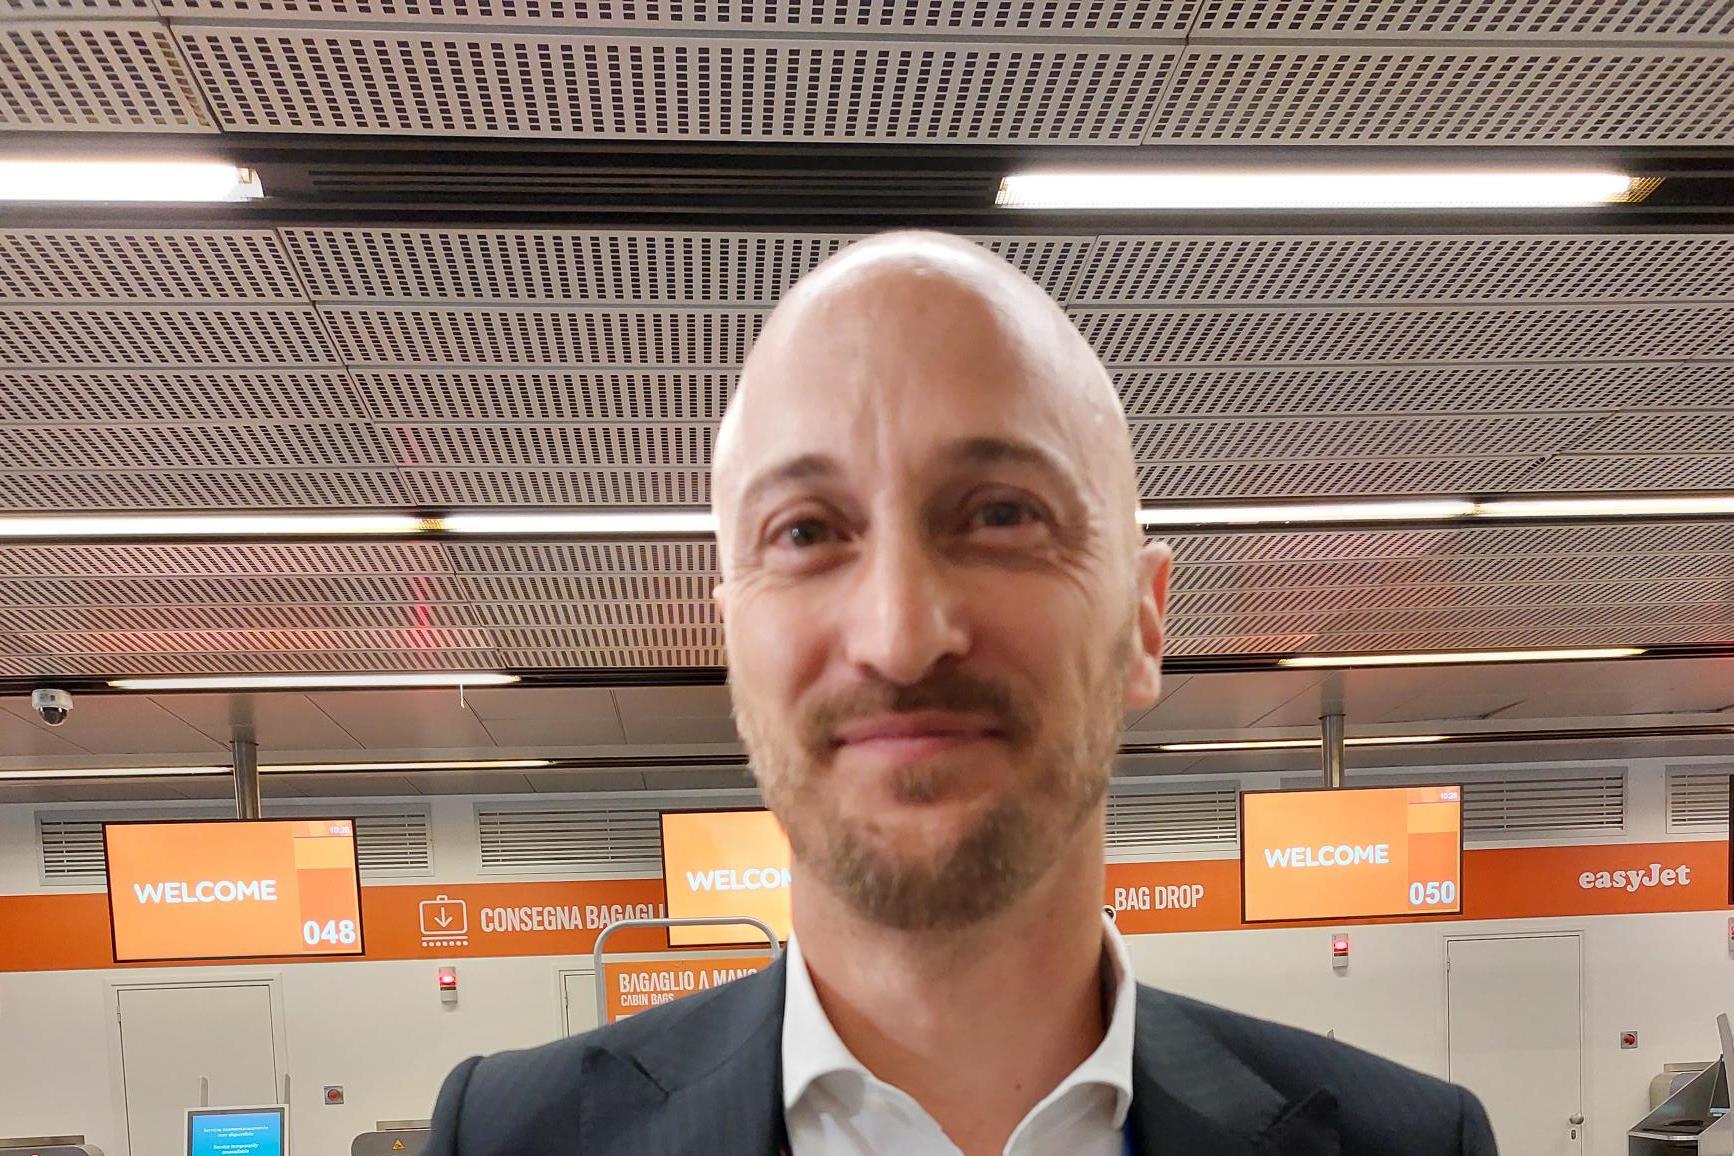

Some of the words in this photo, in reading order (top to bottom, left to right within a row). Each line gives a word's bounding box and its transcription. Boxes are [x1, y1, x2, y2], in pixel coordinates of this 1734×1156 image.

[1264, 843, 1390, 868] WELCOME
[1578, 863, 1691, 892] easyJet
[134, 879, 278, 904] WELCOME
[1114, 886, 1151, 911] BAG
[1154, 884, 1204, 909] DROP
[1409, 880, 1455, 905] 050
[480, 906, 583, 932] CONSEGNA
[303, 920, 356, 945] 048
[619, 970, 694, 993] BAGAGLIO
[698, 969, 710, 990] A
[620, 993, 649, 1007] CABIN
[651, 992, 675, 1006] BAGS
